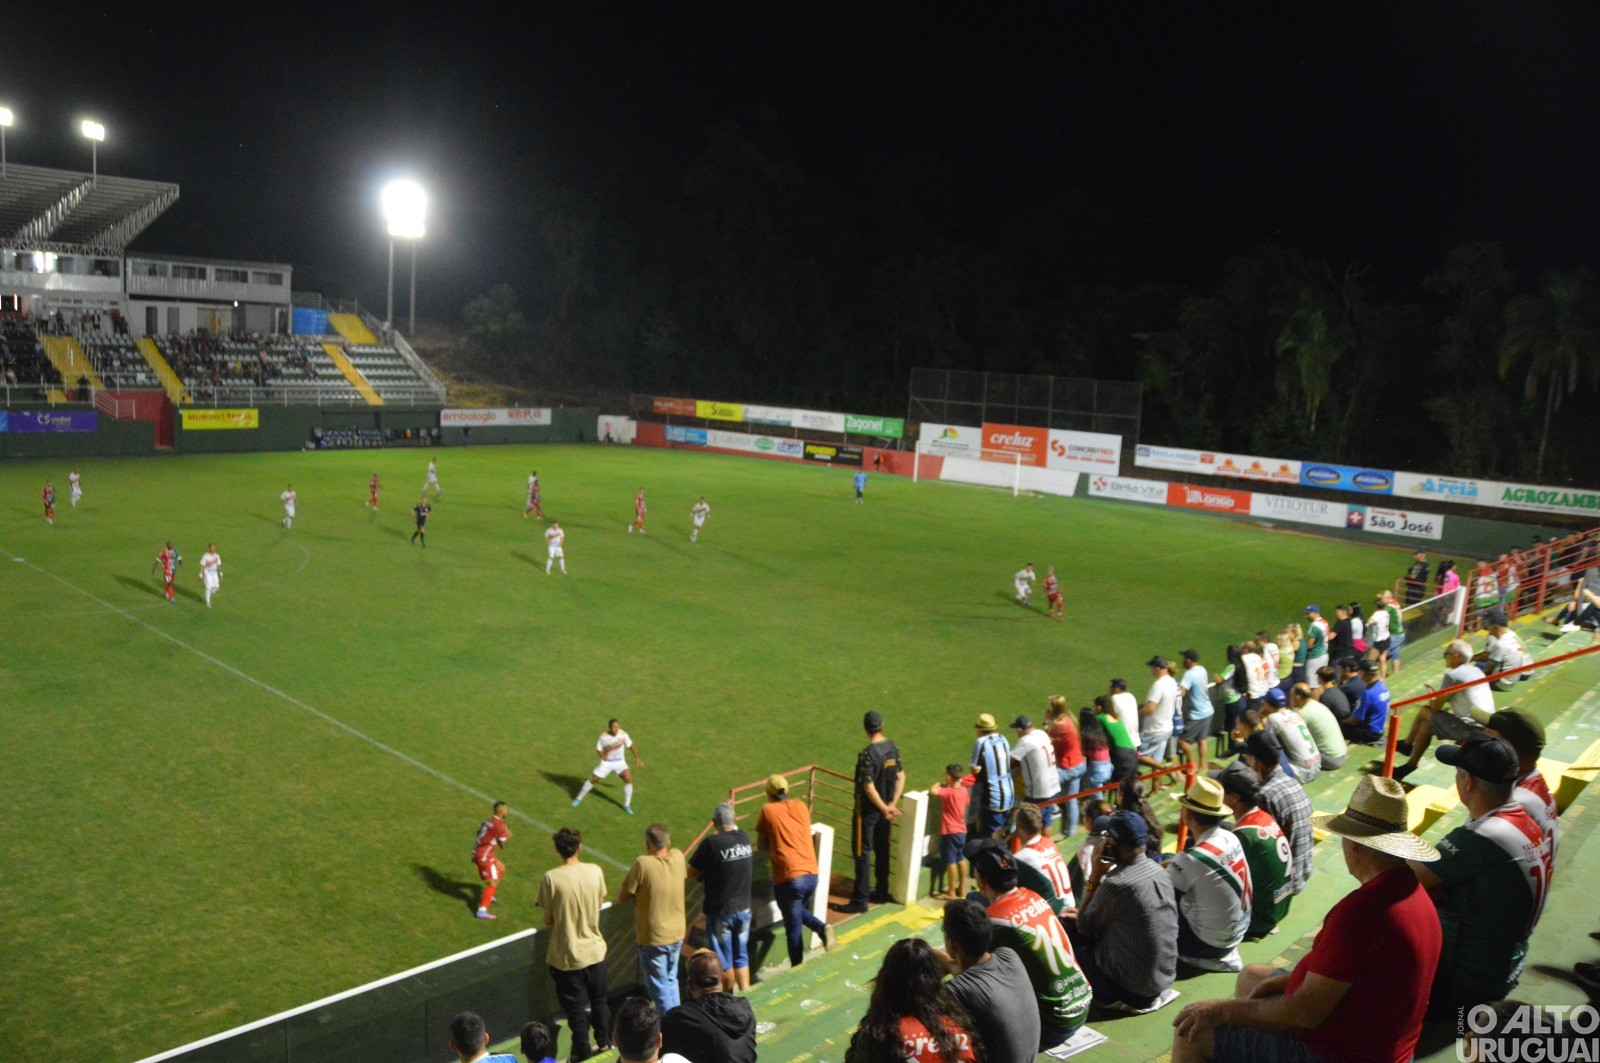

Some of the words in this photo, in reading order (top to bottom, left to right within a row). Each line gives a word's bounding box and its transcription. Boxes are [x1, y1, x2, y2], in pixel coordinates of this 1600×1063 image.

[846, 415, 884, 431] Zagonel
[990, 431, 1034, 447] creluz
[1421, 478, 1478, 497] Areia
[1265, 496, 1329, 515] VITIOTUR
[1370, 515, 1396, 529] São
[1400, 519, 1434, 534] José
[1276, 836, 1293, 878] 9
[1041, 857, 1072, 899] 10
[1032, 915, 1074, 975] 10
